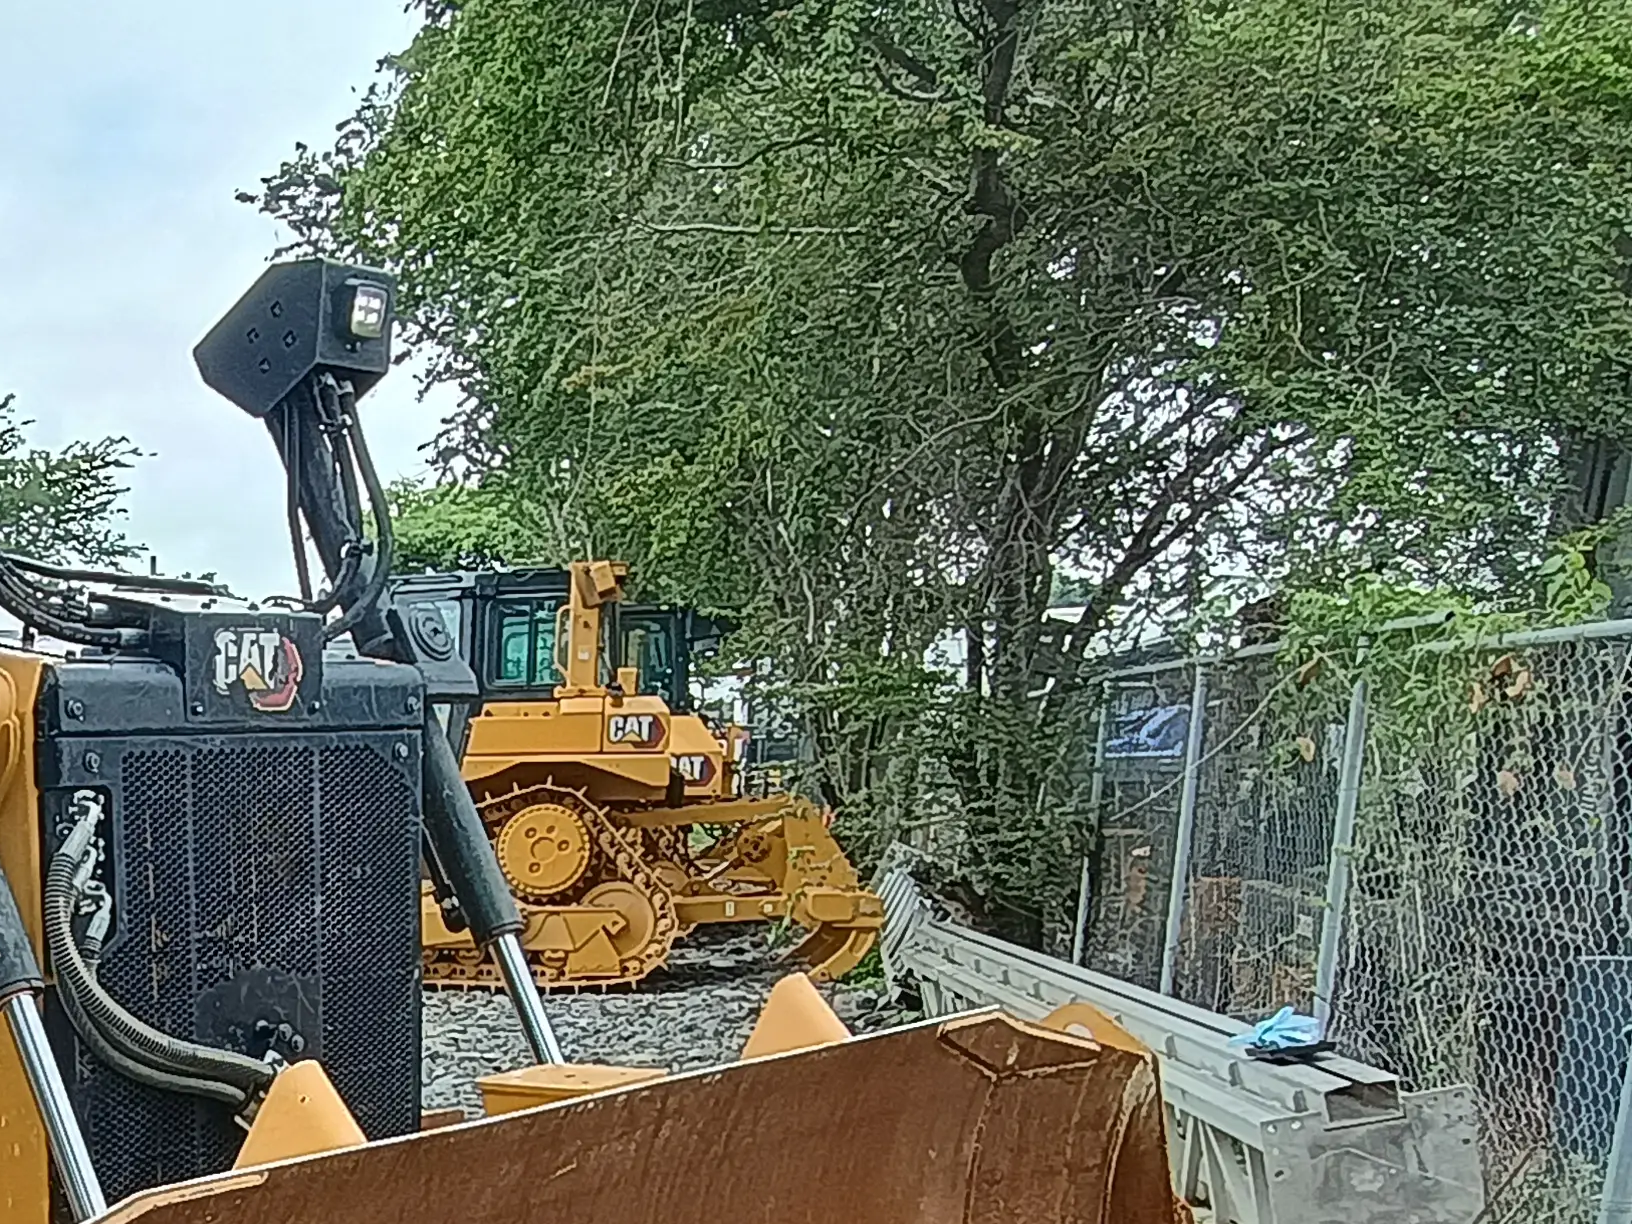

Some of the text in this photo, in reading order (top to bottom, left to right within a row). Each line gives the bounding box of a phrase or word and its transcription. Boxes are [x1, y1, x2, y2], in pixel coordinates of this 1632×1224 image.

[214, 631, 280, 690] CAT
[609, 715, 654, 742] CAT
[670, 756, 705, 780] AT
